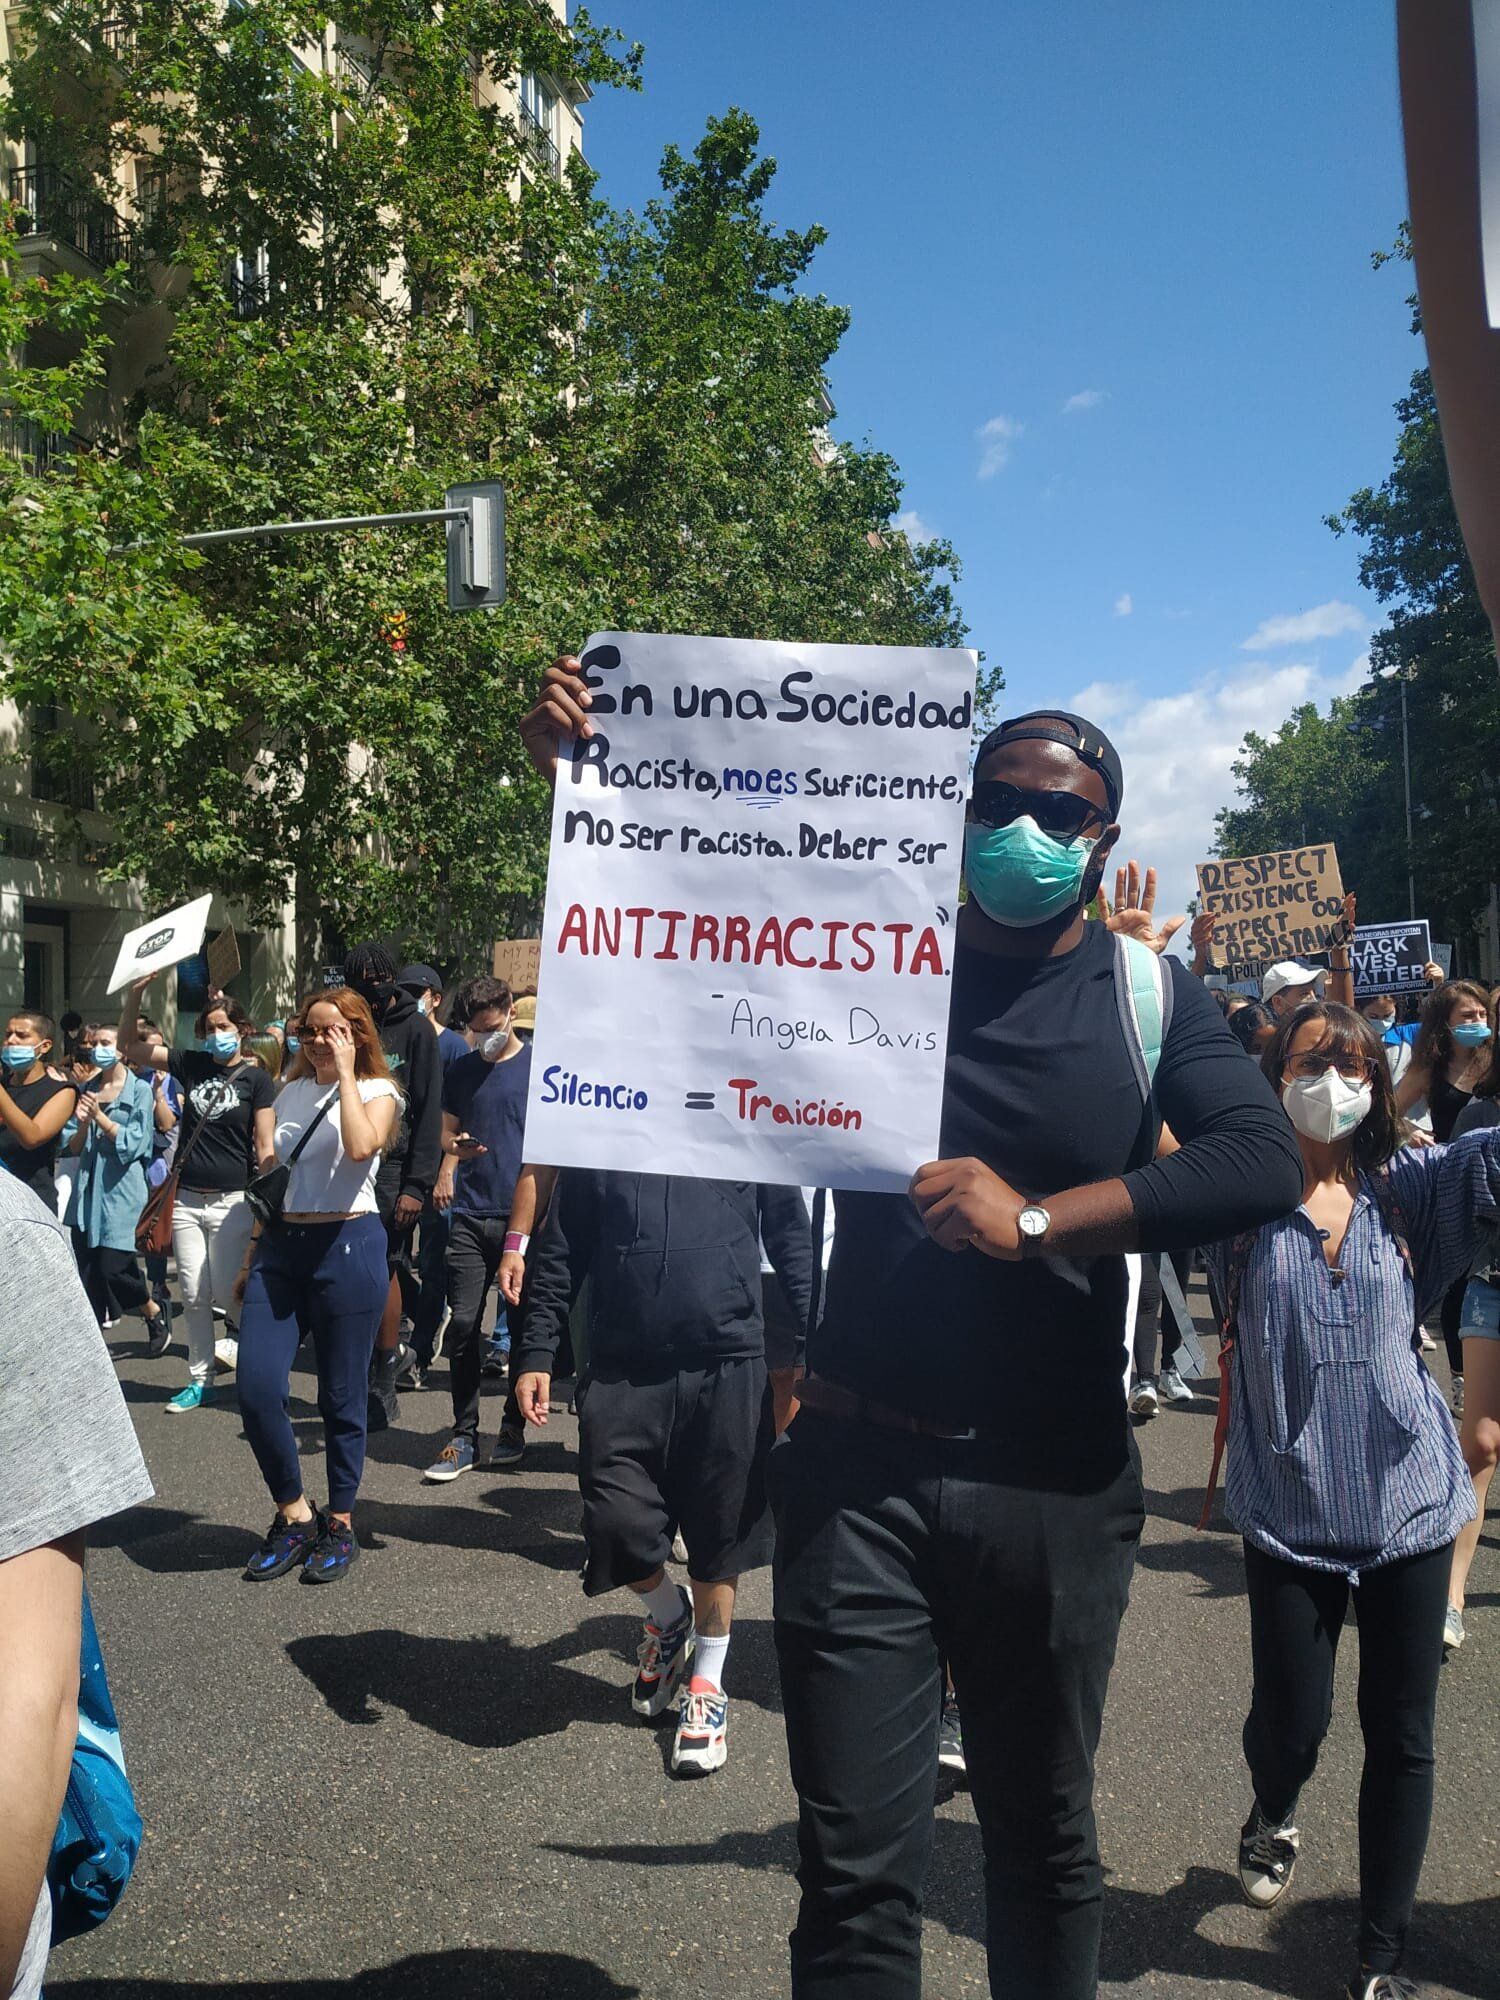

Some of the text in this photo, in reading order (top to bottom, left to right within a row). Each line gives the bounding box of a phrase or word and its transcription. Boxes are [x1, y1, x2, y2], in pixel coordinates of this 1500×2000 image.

[578, 644, 972, 729] En una Sociedad
[570, 732, 722, 800] Racista,
[619, 823, 674, 852] ser
[680, 825, 793, 858] racista.
[897, 838, 948, 865] ser
[1200, 848, 1328, 893] RESPECT
[1207, 879, 1319, 918] EXISTENCE
[1211, 911, 1289, 946] EXPECT
[1350, 936, 1409, 957] LACK
[503, 946, 522, 959] MY
[510, 960, 522, 971] IS
[1235, 960, 1275, 980] POLIC
[1349, 952, 1398, 972] IVES
[1351, 964, 1425, 986] ATTER
[730, 998, 834, 1051] Angela
[847, 1006, 938, 1052] Davis
[540, 1064, 649, 1112] Silencio
[727, 1078, 863, 1132] Traición
